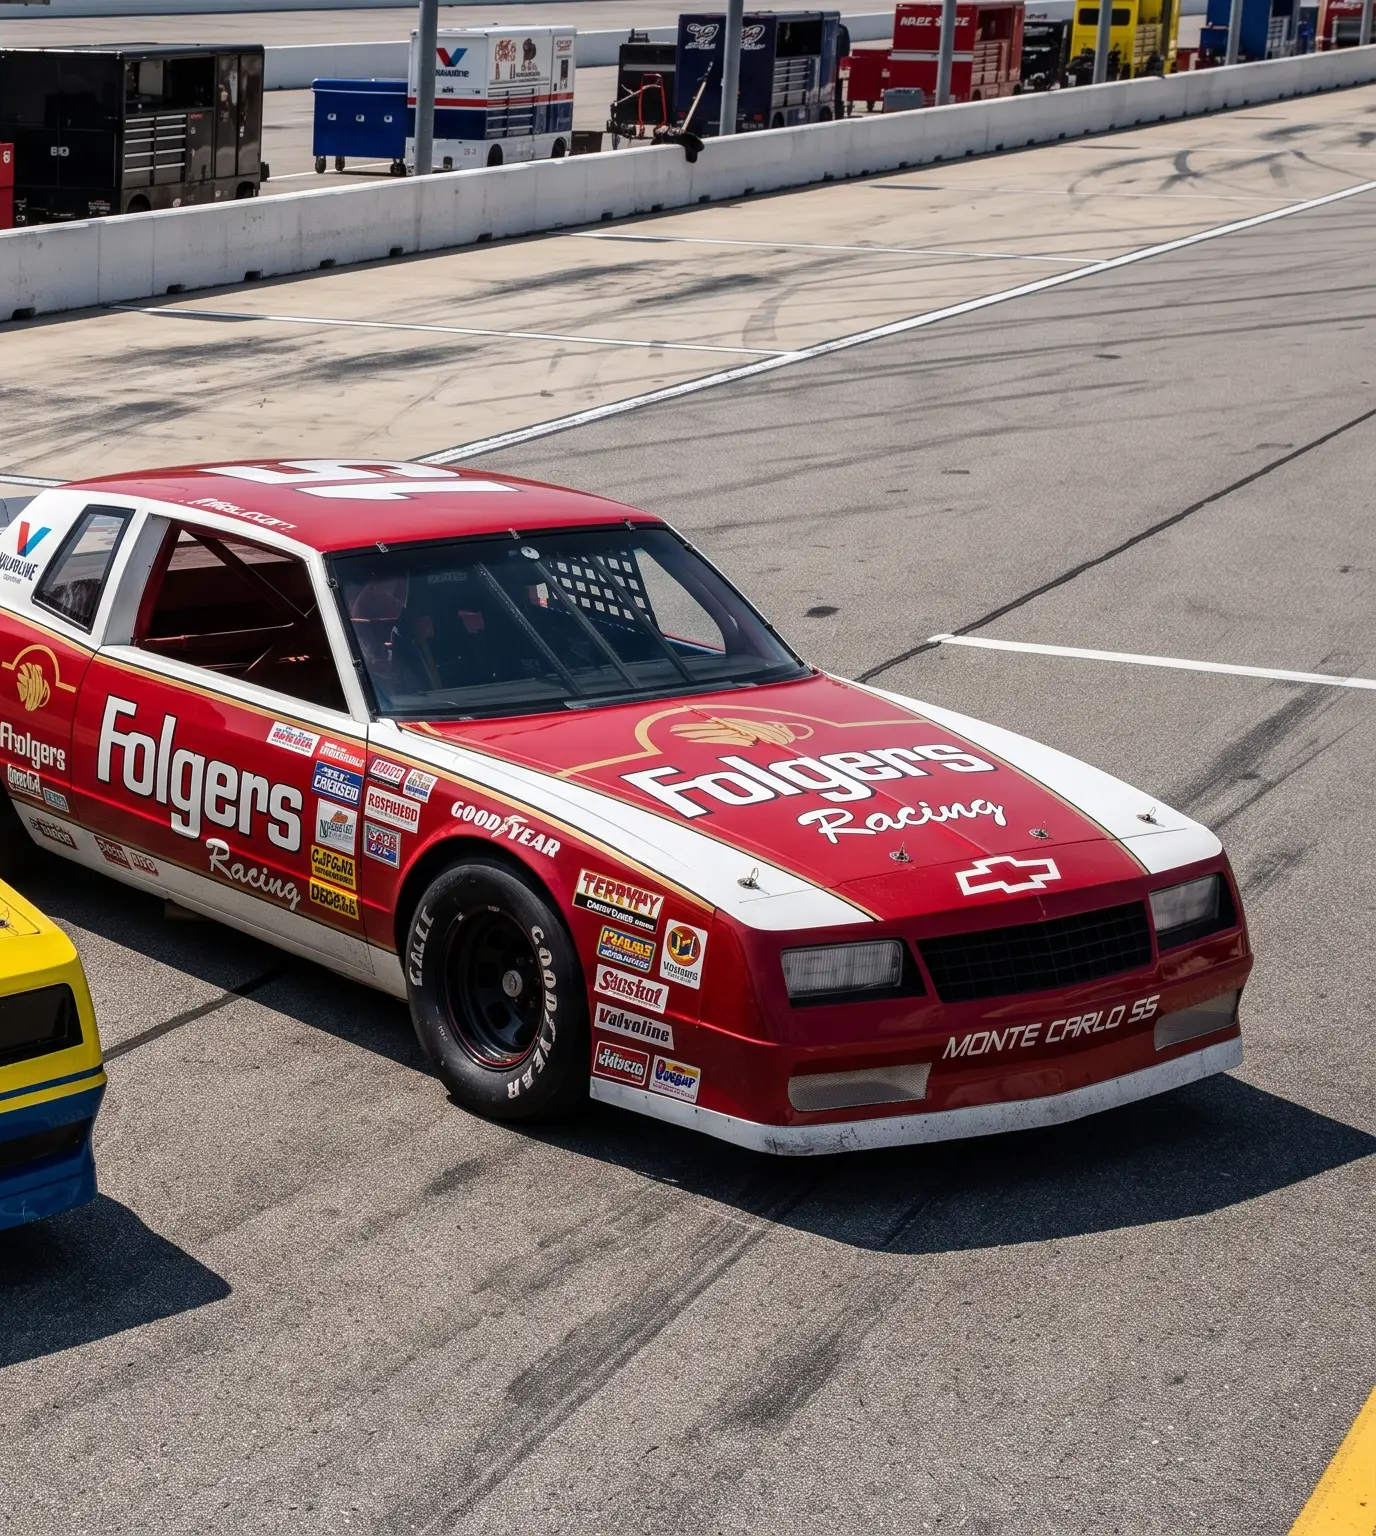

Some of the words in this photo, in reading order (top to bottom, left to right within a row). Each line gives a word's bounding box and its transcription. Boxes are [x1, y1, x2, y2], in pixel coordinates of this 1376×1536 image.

[97, 694, 304, 855] Folgers
[620, 743, 999, 820] Folgers
[796, 798, 1007, 845] Racing
[205, 838, 301, 911] Racing
[942, 1022, 1042, 1059] MONTE
[1045, 1005, 1126, 1043] CARLO
[1128, 994, 1161, 1024] SS
